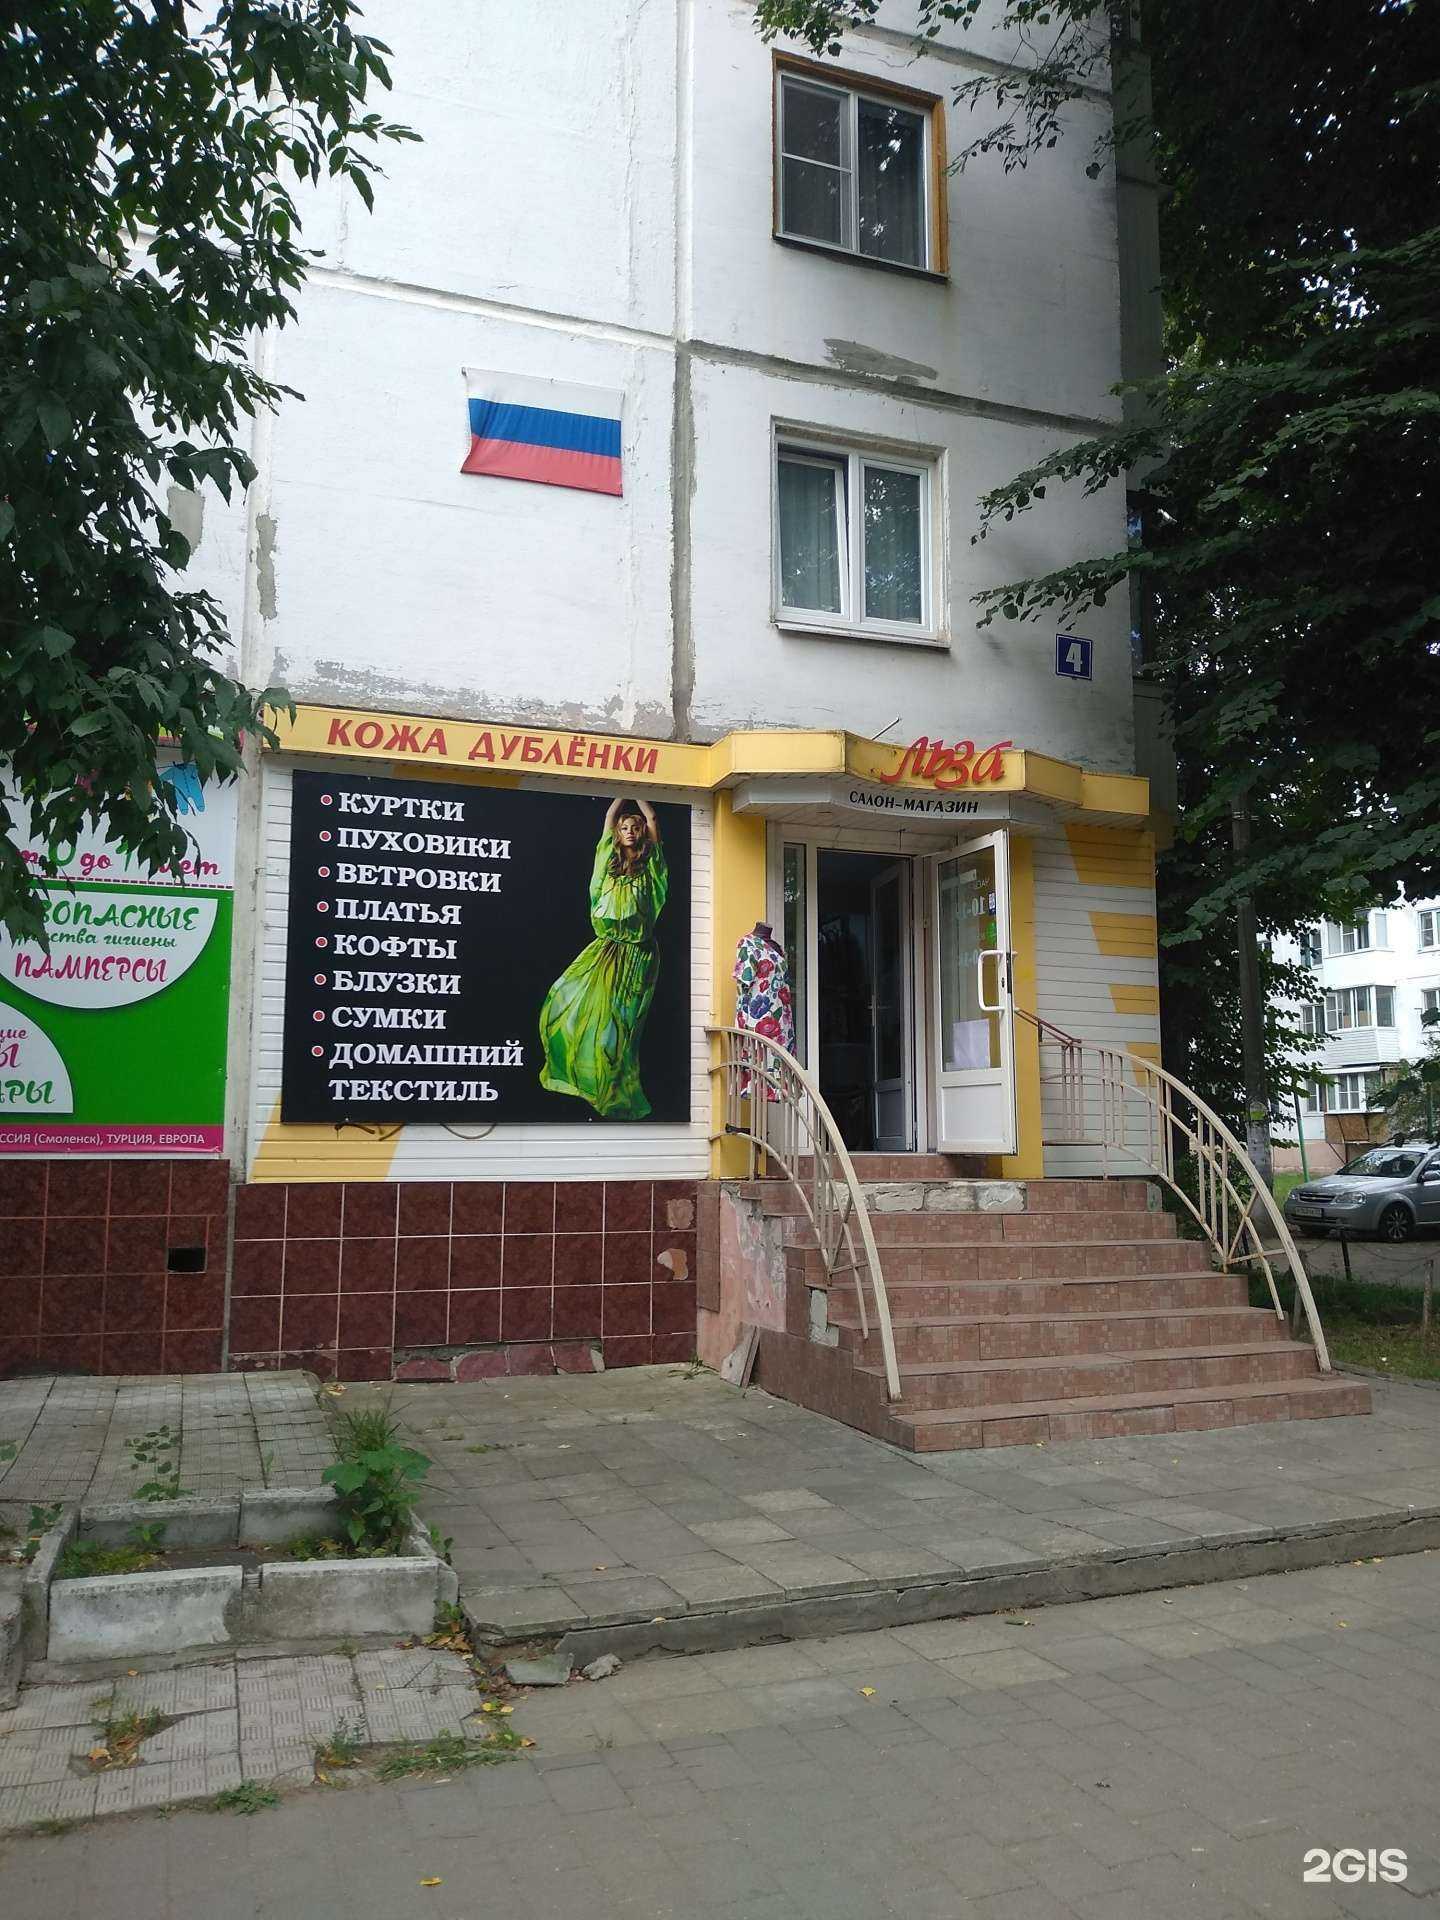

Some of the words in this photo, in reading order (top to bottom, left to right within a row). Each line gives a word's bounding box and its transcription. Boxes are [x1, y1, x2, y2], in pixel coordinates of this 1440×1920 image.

[1065, 642, 1083, 673] 4
[326, 718, 449, 756] КОЖА
[467, 731, 659, 774] ДУБЛЁНКИ
[338, 792, 465, 822] КУРТКИ
[849, 790, 979, 814] САЛОН-МАГАЗИН
[337, 827, 512, 860] ПУХОВИКИ
[80, 852, 112, 877] до
[335, 862, 502, 893] ВЕТРОВКИ
[334, 898, 463, 925] ПЛАТЬЯ
[103, 935, 177, 948] гигиены
[333, 933, 458, 960] КОФТЫ
[15, 953, 169, 983] ПАМПЕРСЫ
[332, 970, 462, 995] БЛУЗКИ
[331, 1006, 447, 1030] СУМКИ
[328, 1039, 524, 1070] ДОМАШНИЙ
[328, 1079, 499, 1101] ТЕКСТИЛЬ
[34, 1132, 103, 1147] (Смоленск),
[106, 1133, 156, 1146] ТУРЦИЯ,
[159, 1133, 206, 1145] ЕВРОПА
